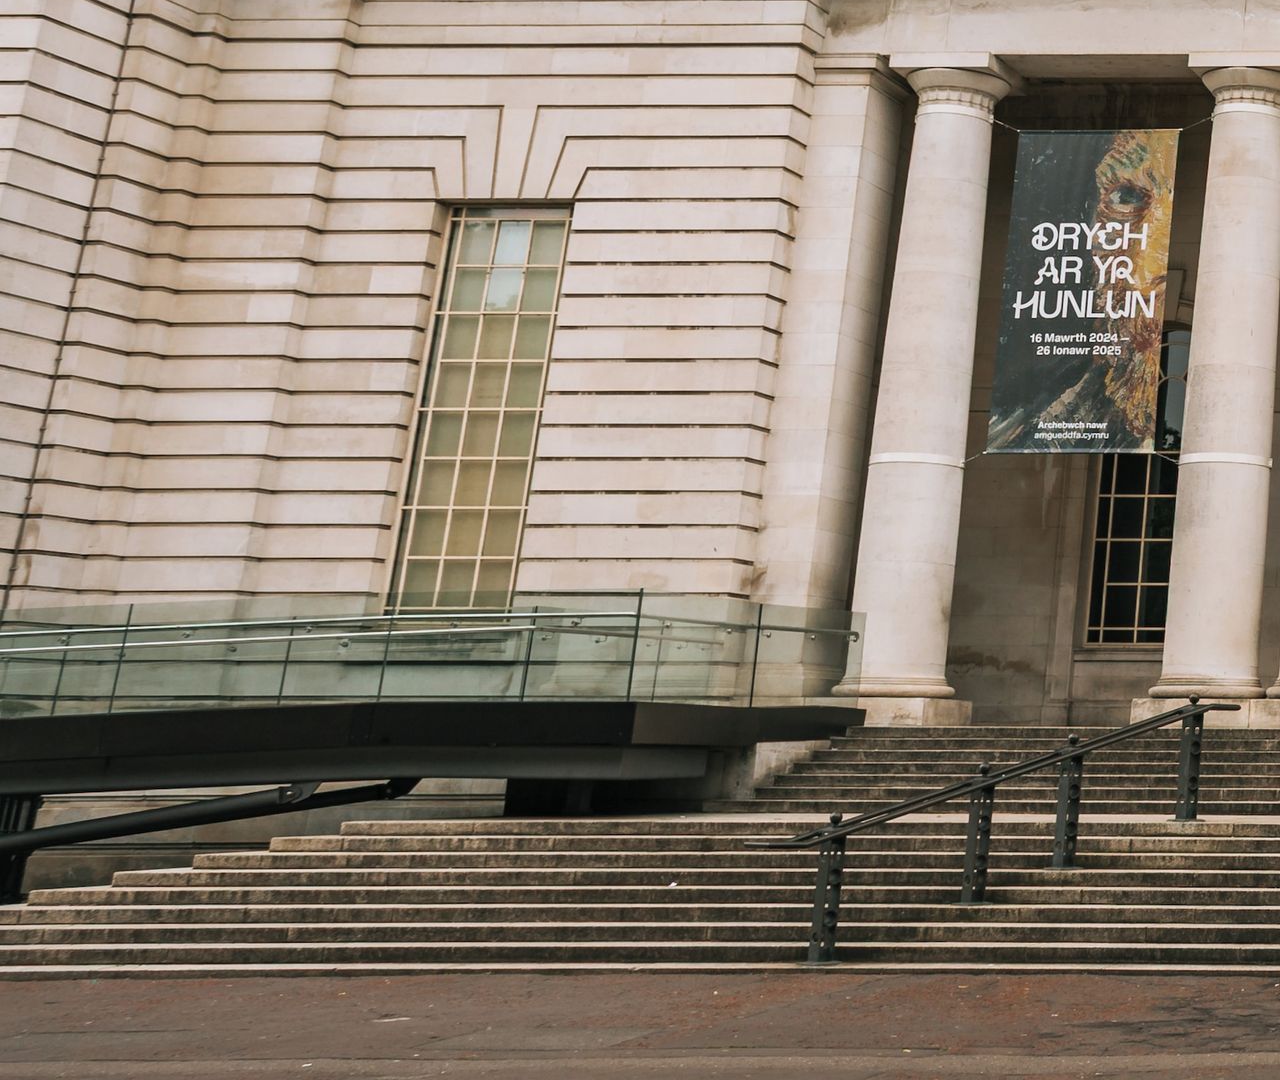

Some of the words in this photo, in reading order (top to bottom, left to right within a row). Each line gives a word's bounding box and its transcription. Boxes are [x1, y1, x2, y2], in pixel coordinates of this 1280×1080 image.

[1031, 222, 1149, 251] DRYCH
[1033, 256, 1084, 285] AR
[1092, 256, 1137, 285] YR
[1012, 290, 1156, 319] HUNLUN
[1030, 333, 1043, 343] 16
[1044, 333, 1087, 343] Mawrth
[1089, 333, 1118, 343] 2024
[1036, 345, 1050, 355] 26
[1053, 345, 1090, 355] Ionawr
[1092, 345, 1121, 355] 2025
[1037, 421, 1085, 429] Archebwch
[1034, 431, 1110, 441] amgueddfa.cymru
